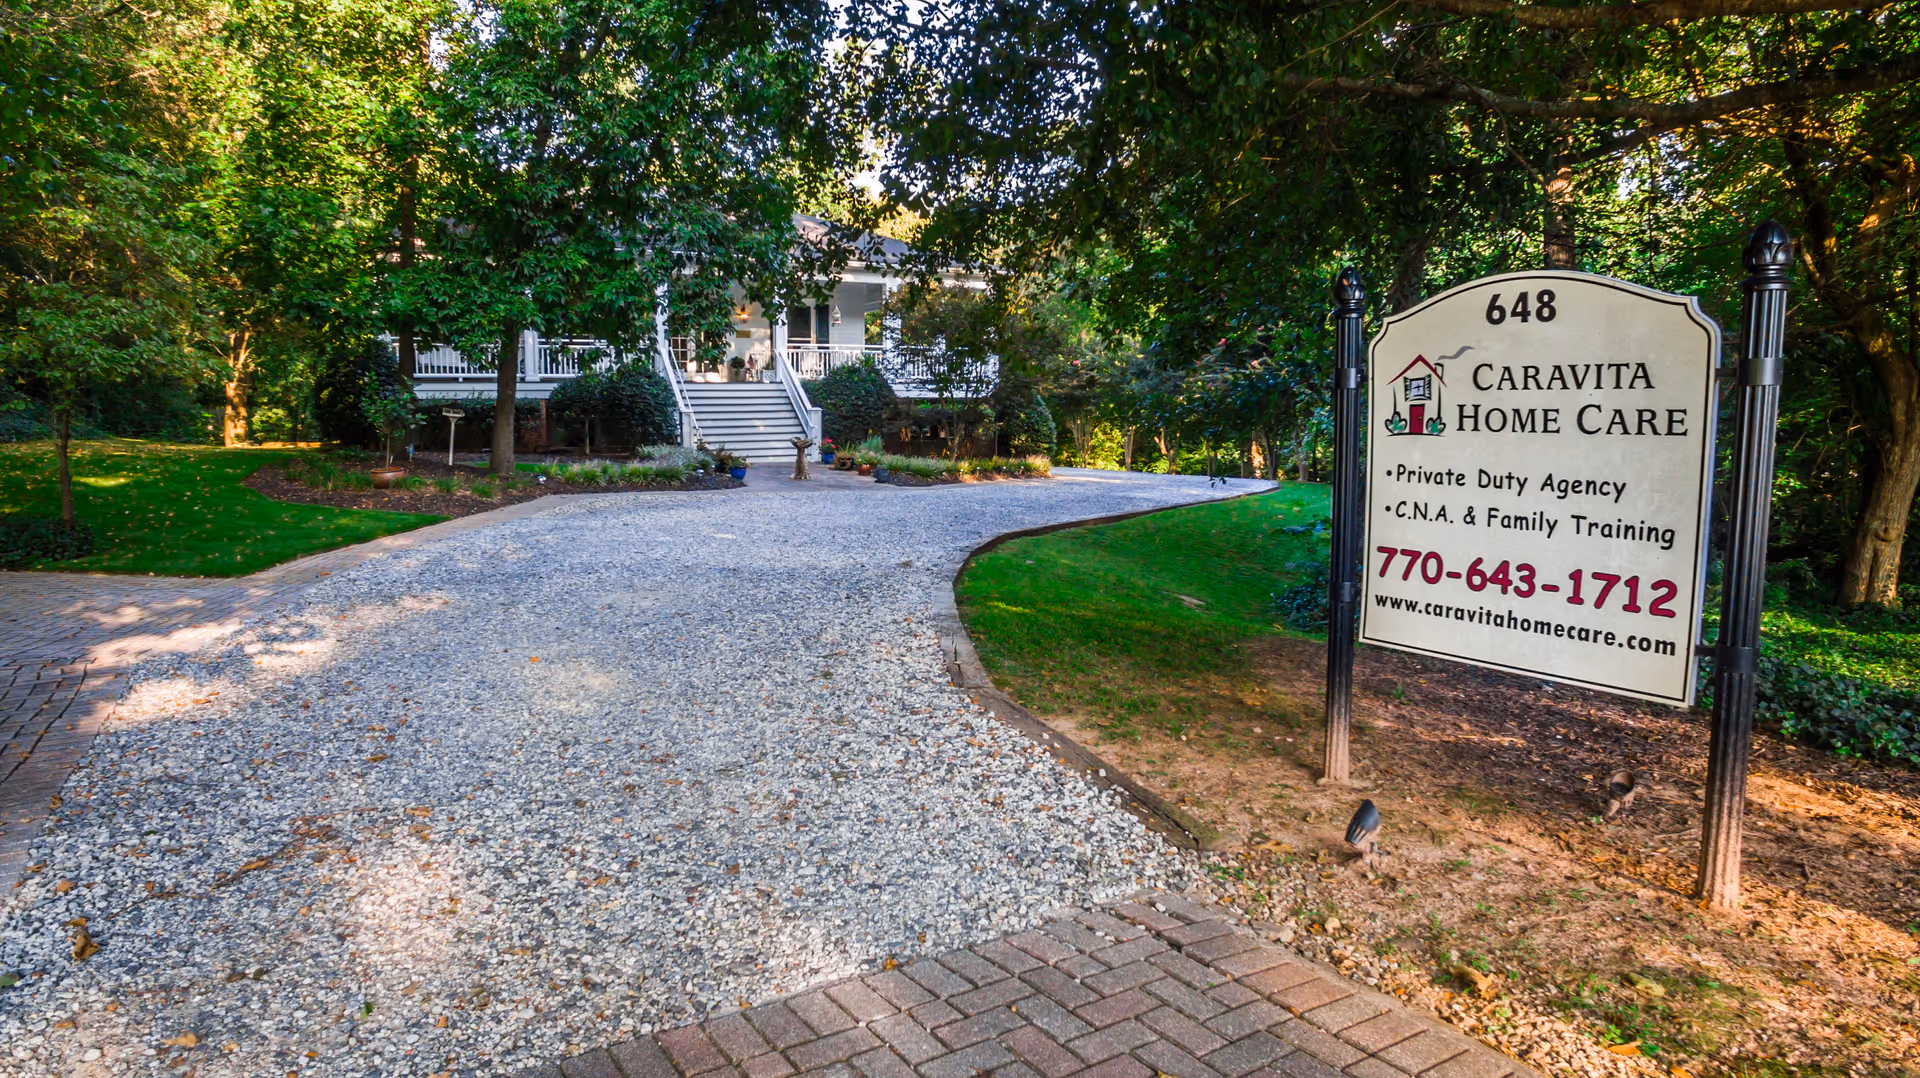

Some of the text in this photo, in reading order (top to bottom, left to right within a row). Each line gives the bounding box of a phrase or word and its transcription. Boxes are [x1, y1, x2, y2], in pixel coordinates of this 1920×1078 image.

[1485, 289, 1557, 325] 648
[1472, 362, 1656, 392] CARAVITA
[1456, 403, 1689, 437] HOME CARE
[1396, 463, 1627, 503] Private Duty Agency
[1395, 501, 1676, 551] C.N.A. & Family Training
[1376, 545, 1678, 619] 770-643-1712
[1374, 594, 1677, 657] www.caravitahomecare.com
